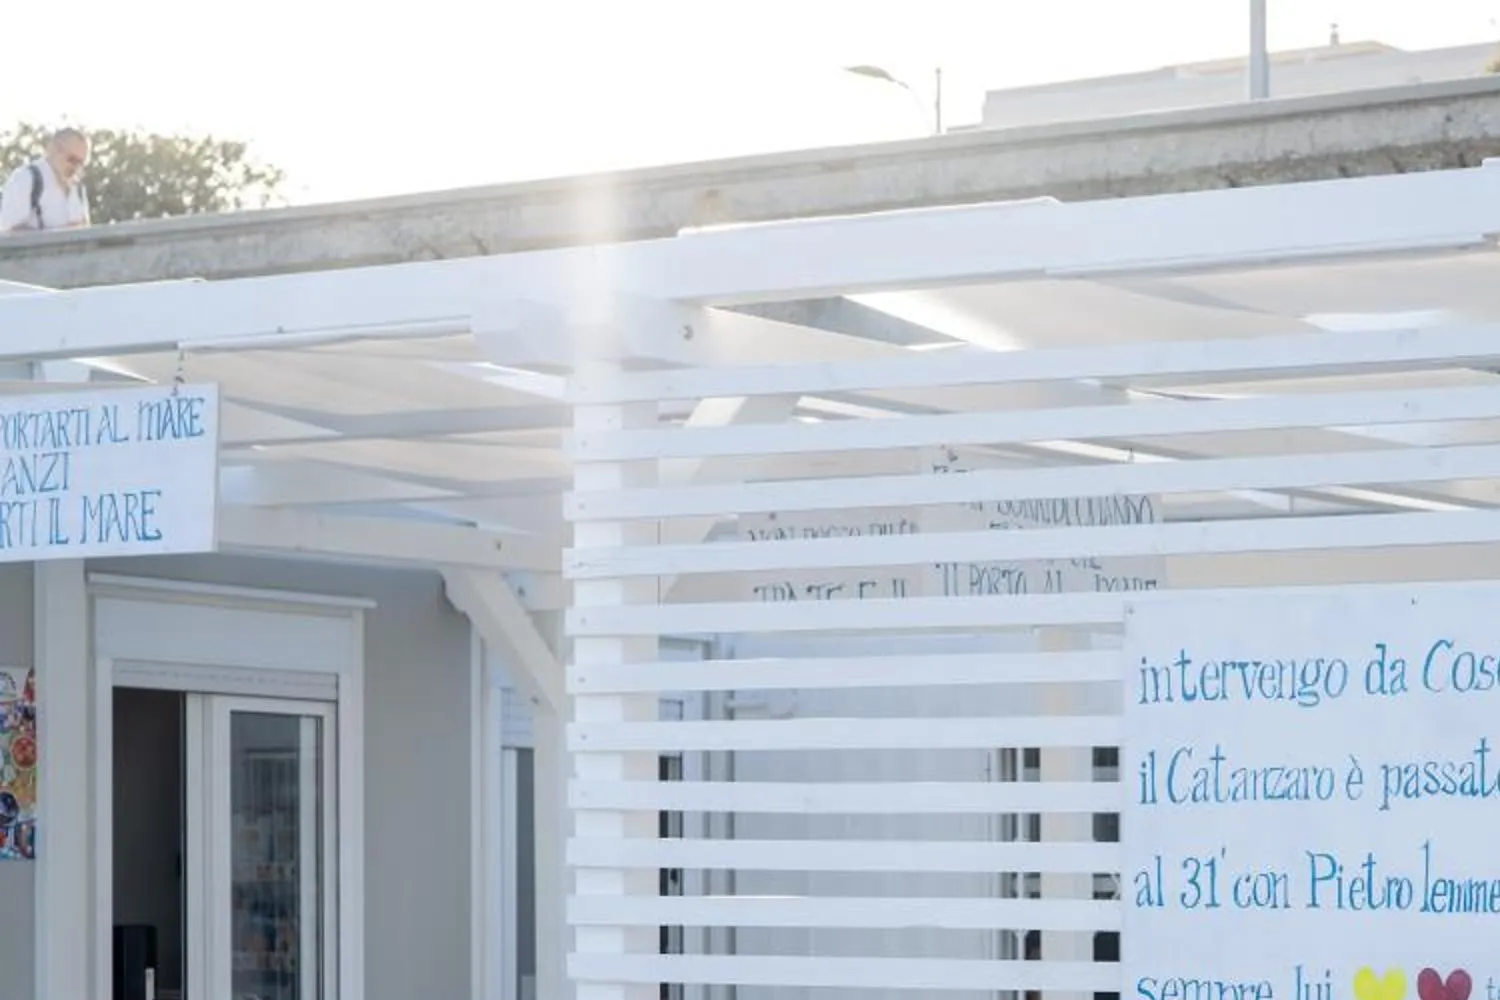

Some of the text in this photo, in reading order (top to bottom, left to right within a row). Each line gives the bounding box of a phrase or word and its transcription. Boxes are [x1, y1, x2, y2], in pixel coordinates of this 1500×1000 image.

[97, 405, 129, 444] AL
[138, 397, 205, 441] MARE
[1, 452, 71, 496] ANZI
[48, 497, 69, 544] IL
[80, 490, 163, 544] MARE
[1138, 649, 1348, 707] intervengo
[1365, 643, 1408, 695] da
[1139, 749, 1158, 805] il
[1167, 743, 1335, 805] Catanzaro
[1345, 752, 1364, 801] è
[1134, 855, 1165, 909] al
[1233, 870, 1291, 909] con
[1305, 850, 1413, 911] Pietro
